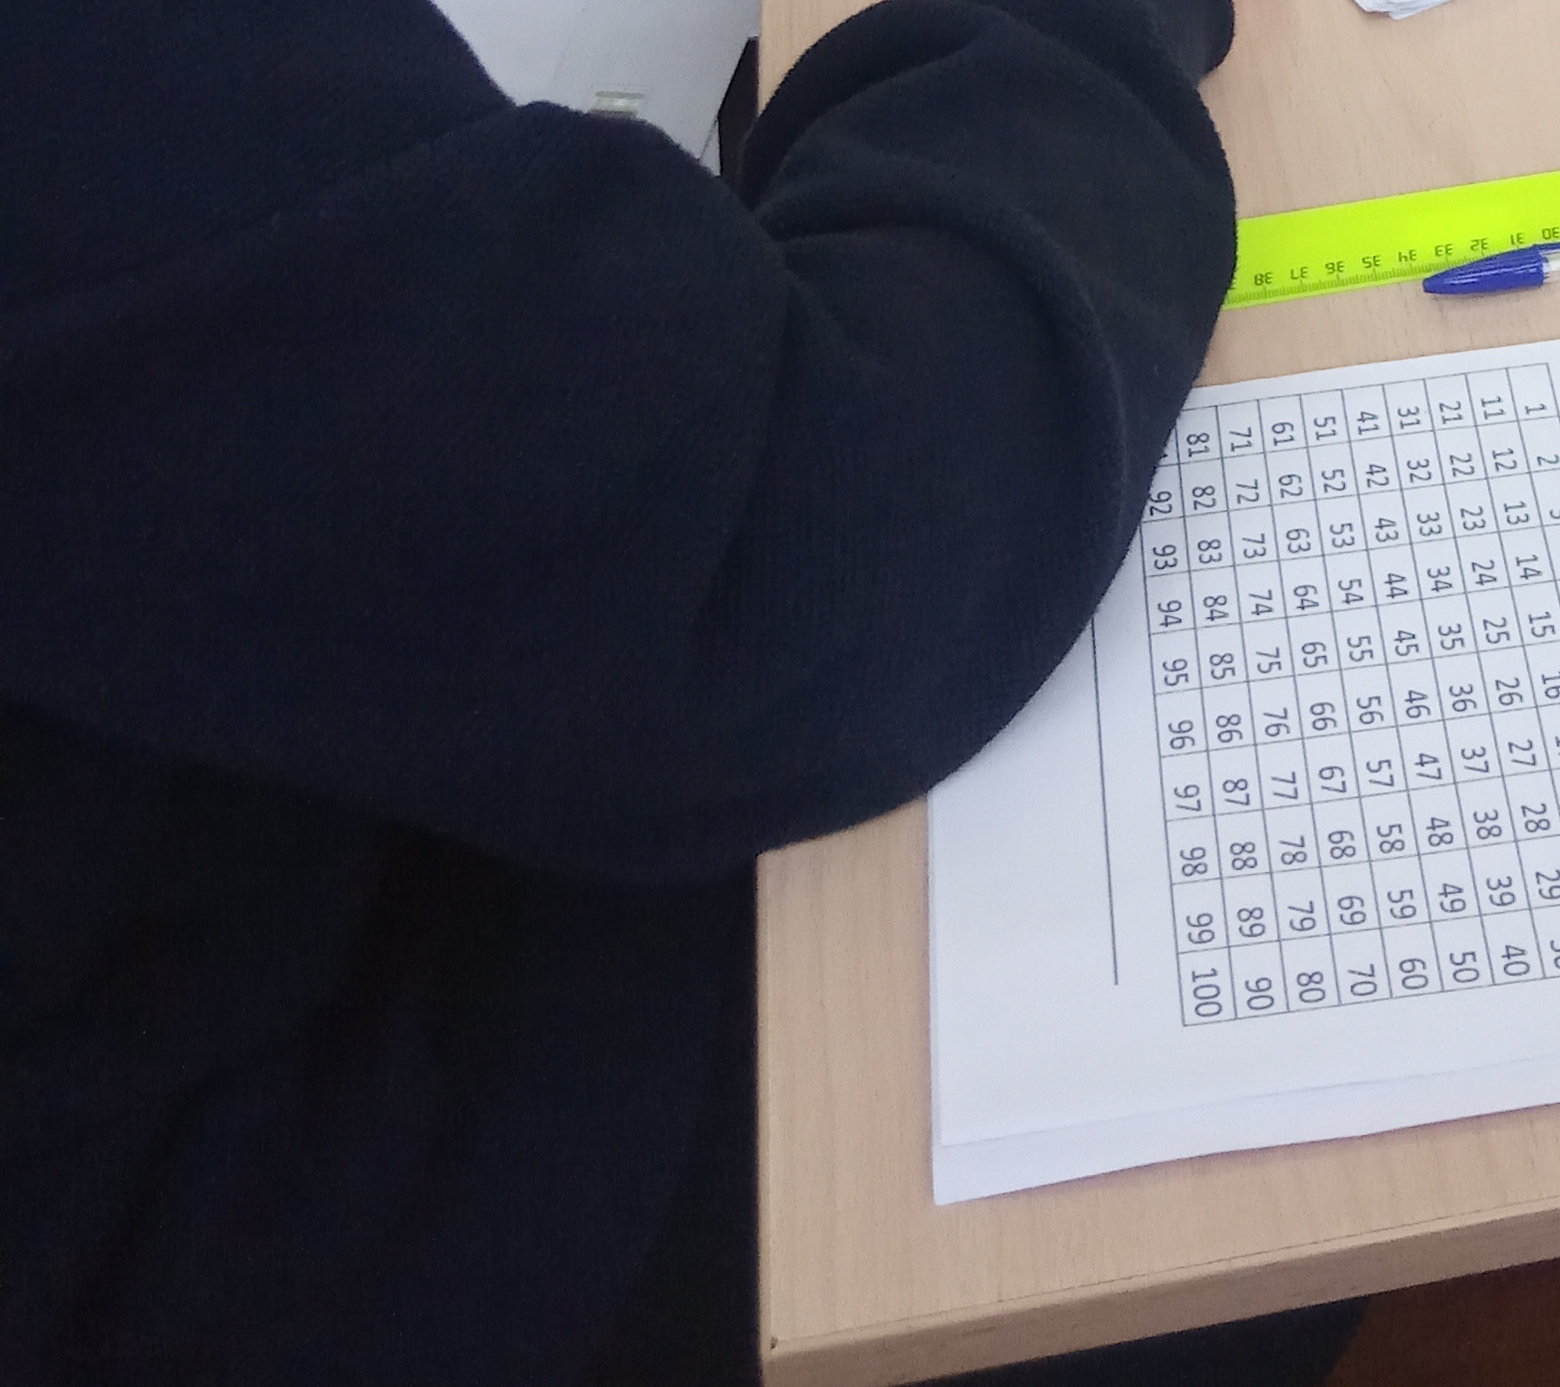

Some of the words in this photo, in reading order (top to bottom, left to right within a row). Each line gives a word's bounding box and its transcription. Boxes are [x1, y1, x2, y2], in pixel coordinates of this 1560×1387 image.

[1468, 236, 1489, 251] 32
[1508, 231, 1526, 245] 31
[1540, 224, 1560, 240] 30
[1360, 253, 1382, 268] 35
[1396, 248, 1418, 262] 34
[1433, 242, 1454, 257] 33
[1252, 270, 1274, 285] 38
[1288, 265, 1309, 280] 37
[1323, 259, 1345, 274] 36
[1438, 400, 1464, 426] 21
[1523, 402, 1548, 416] 1
[1312, 415, 1338, 442] 51
[1448, 452, 1476, 478] 22
[1535, 453, 1560, 467] 2
[1320, 468, 1347, 494] 52
[1459, 505, 1487, 532] 23
[1329, 522, 1356, 549] 53
[1470, 558, 1498, 586] 24
[1337, 578, 1365, 606] 54
[1481, 616, 1511, 645] 25
[1346, 634, 1375, 663] 55
[1494, 676, 1524, 707] 26
[1355, 695, 1385, 726] 56
[1507, 738, 1538, 767] 27
[1365, 758, 1395, 788] 57
[1519, 802, 1551, 834] 28
[1375, 822, 1406, 854] 58
[1386, 888, 1417, 920] 59
[1398, 957, 1430, 991] 60
